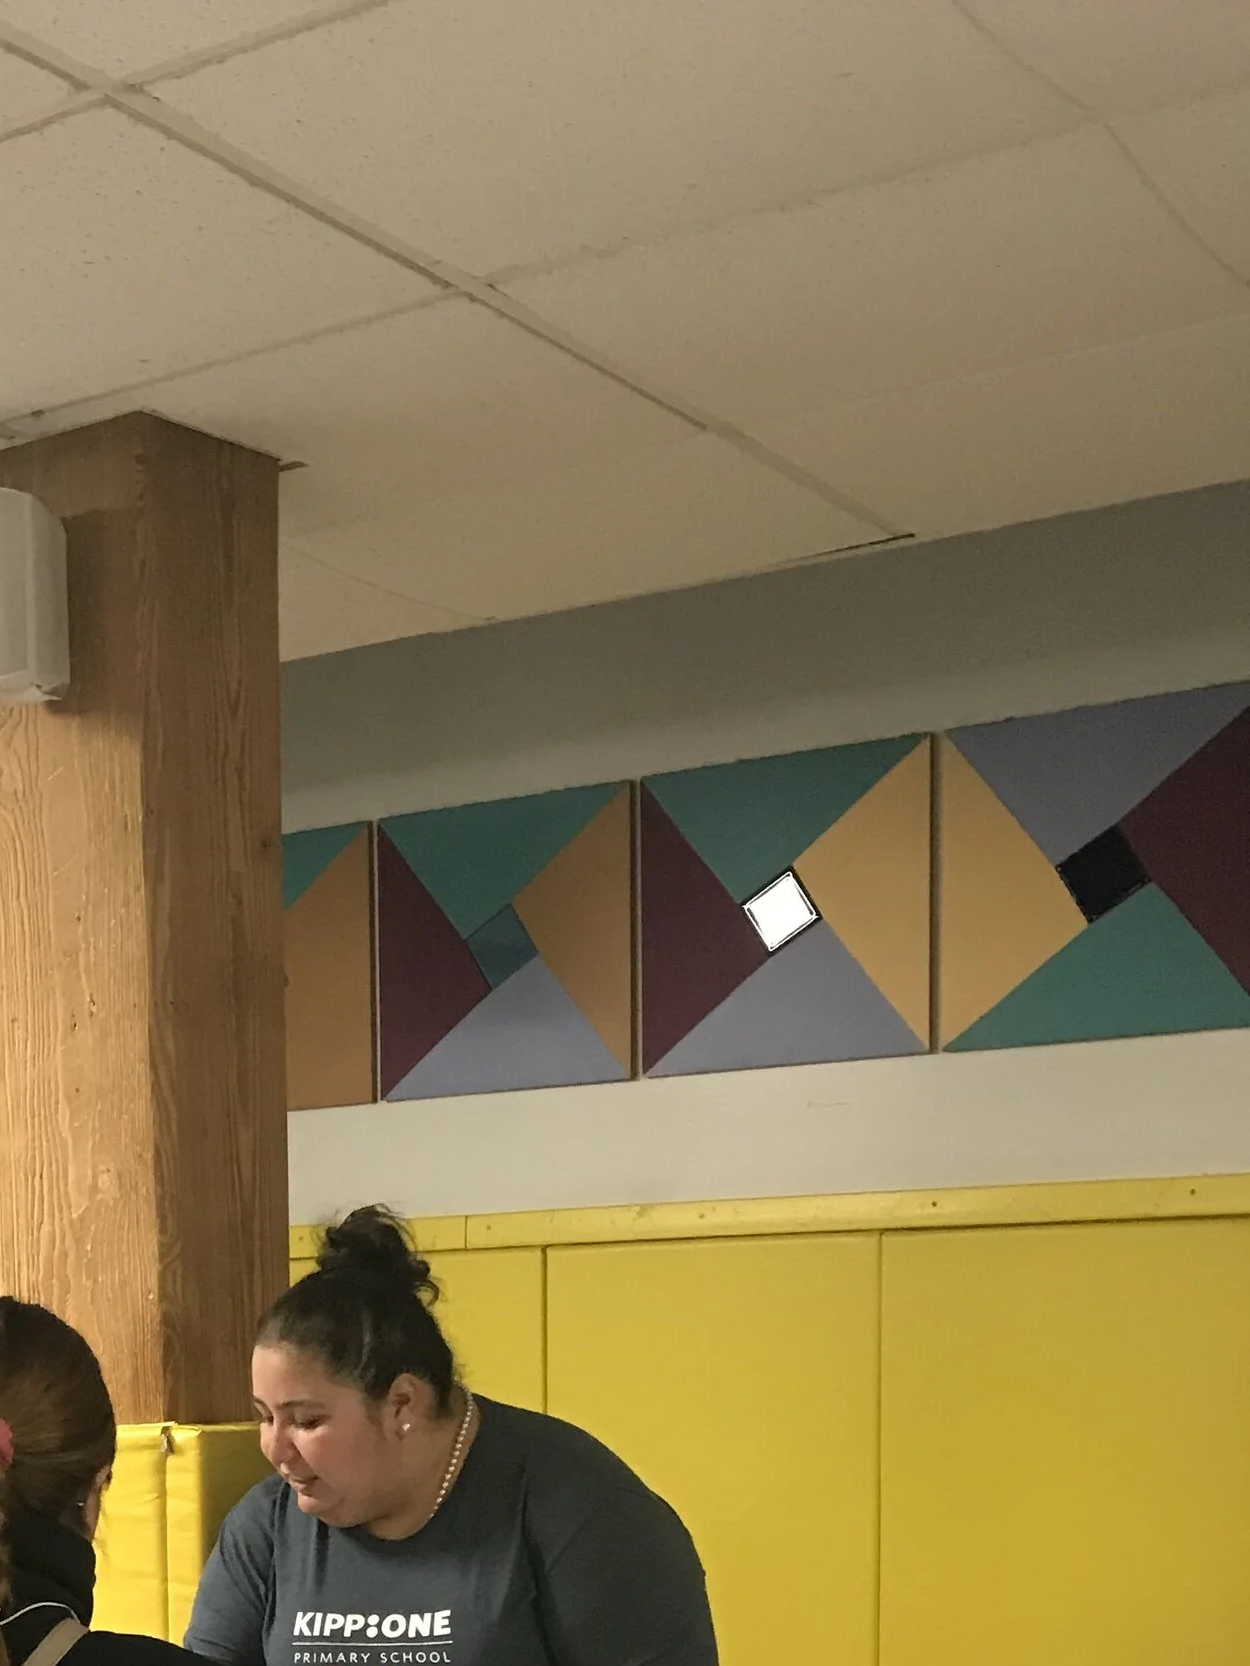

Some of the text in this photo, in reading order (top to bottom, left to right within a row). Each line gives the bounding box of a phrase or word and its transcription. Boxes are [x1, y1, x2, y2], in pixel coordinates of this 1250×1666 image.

[293, 1609, 452, 1639] KIPP:ONE
[293, 1651, 452, 1664] PRIMARY SCHOOL
